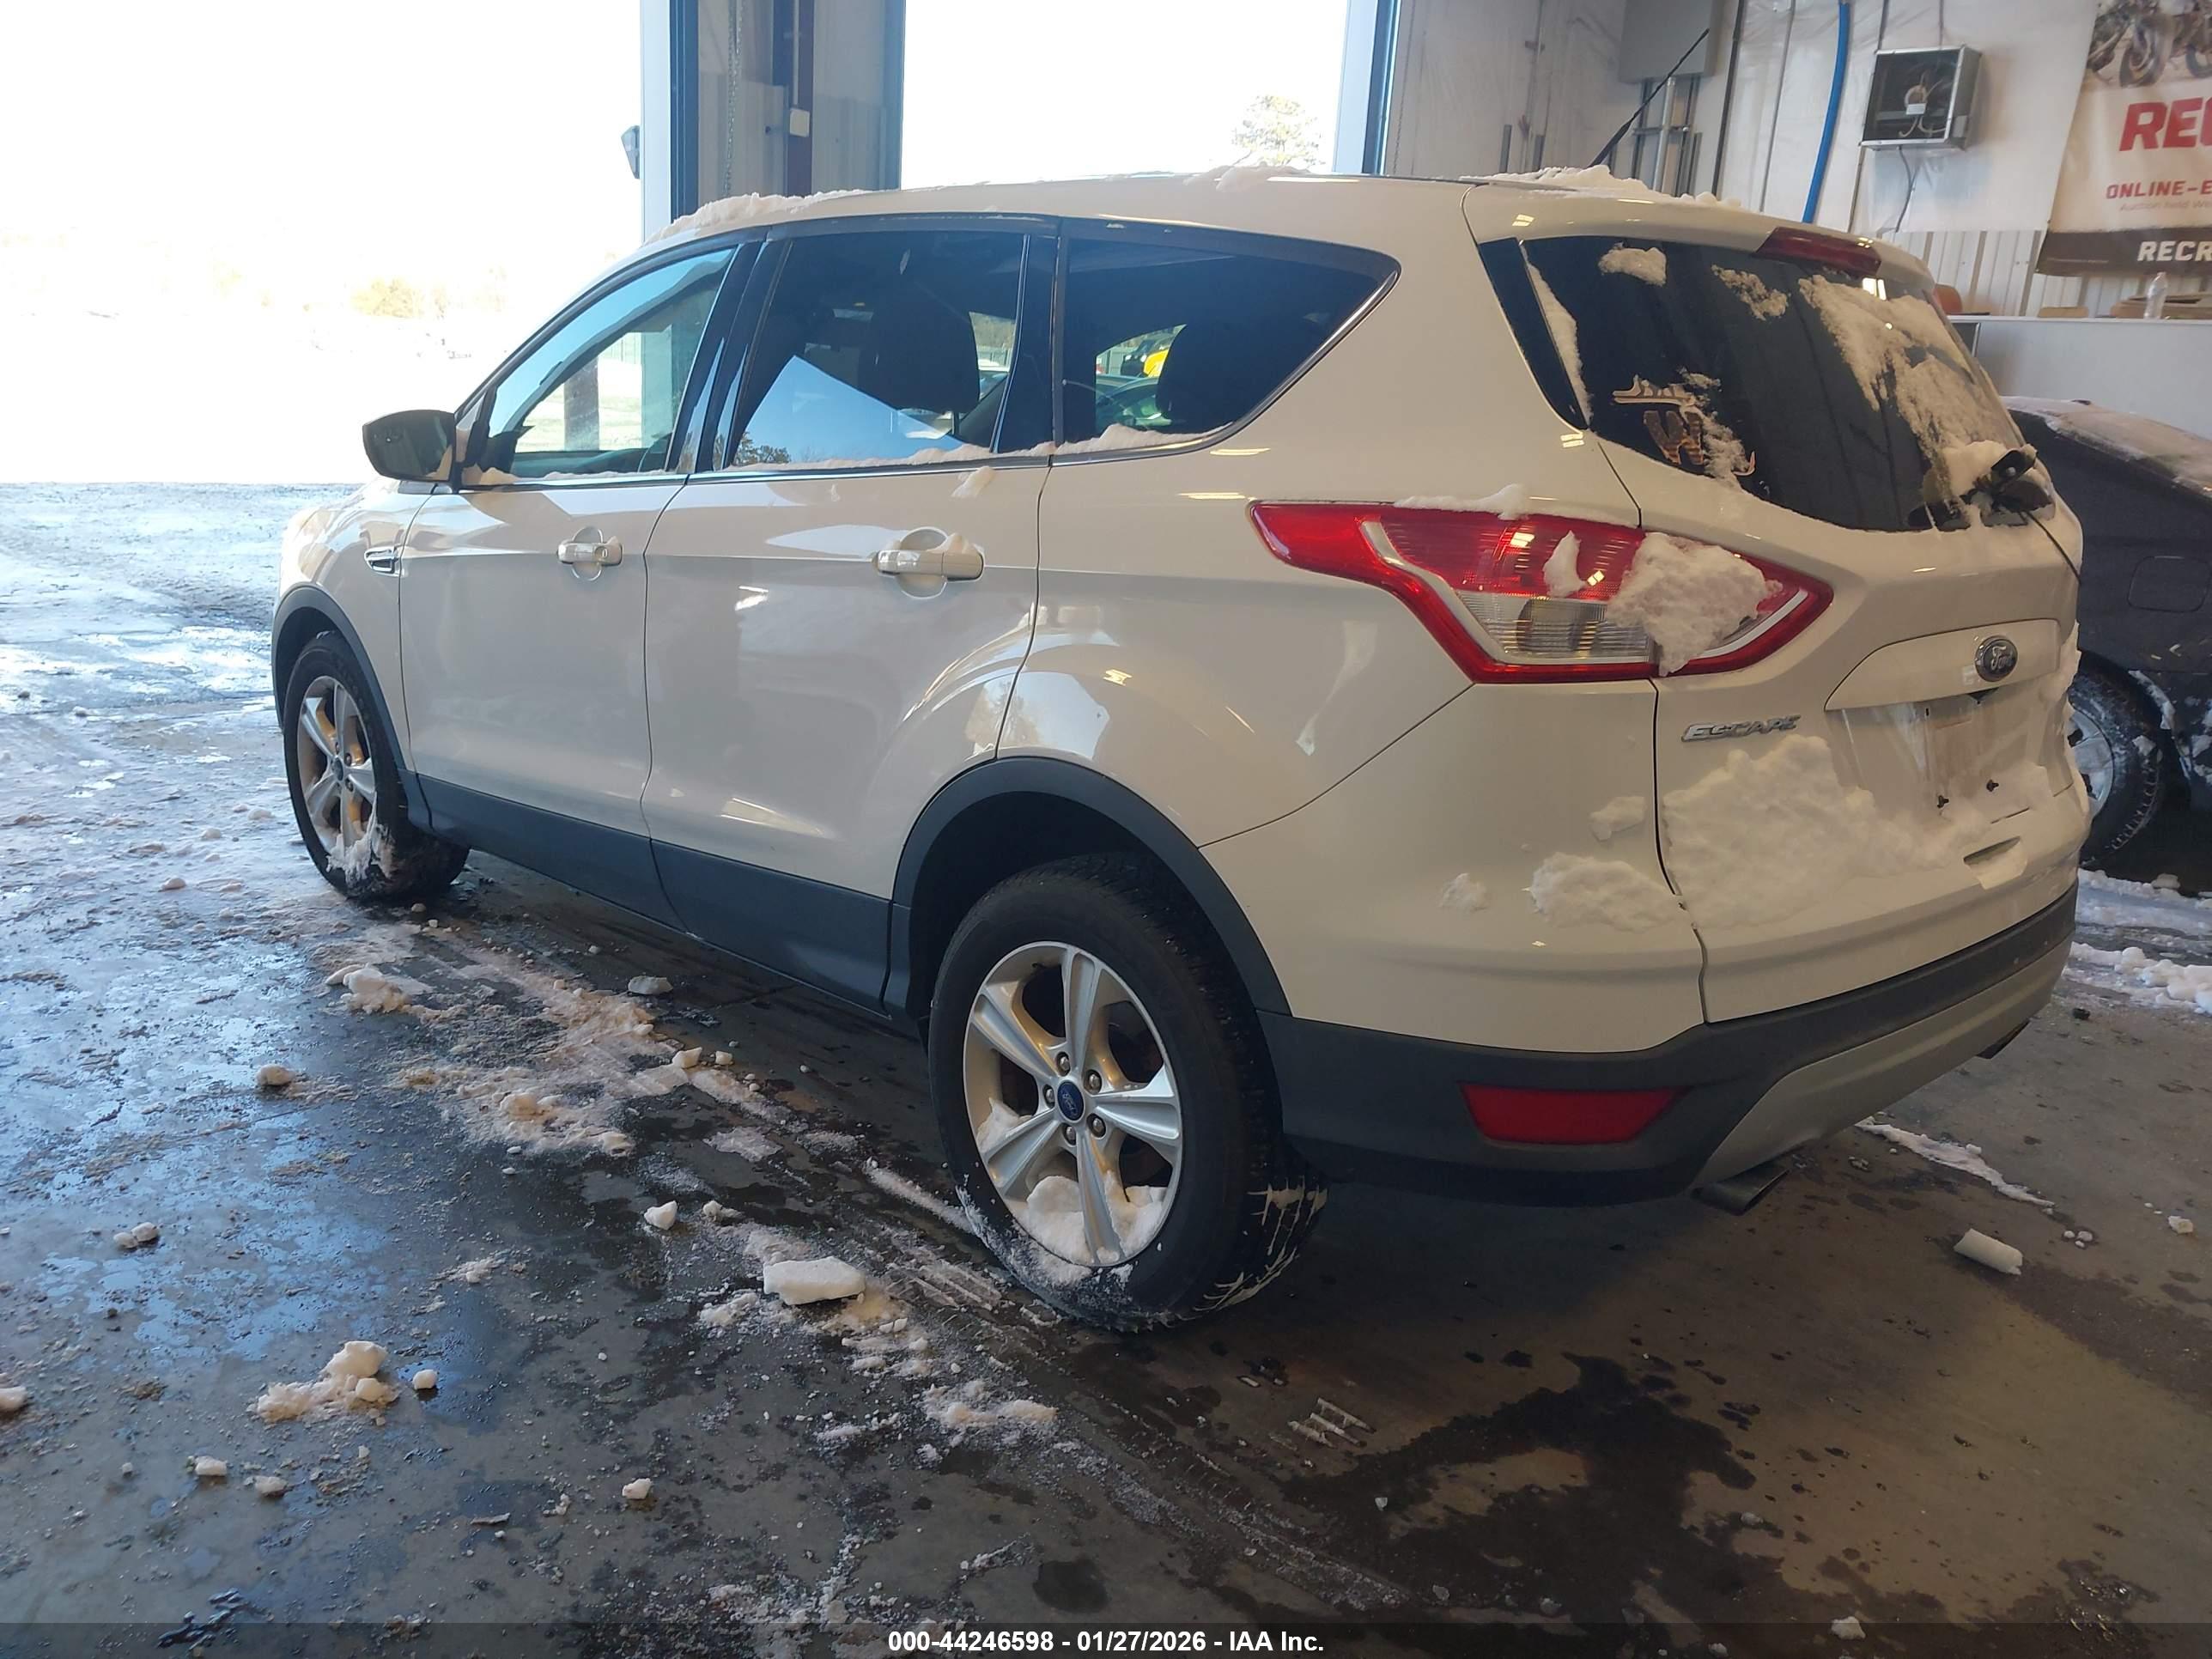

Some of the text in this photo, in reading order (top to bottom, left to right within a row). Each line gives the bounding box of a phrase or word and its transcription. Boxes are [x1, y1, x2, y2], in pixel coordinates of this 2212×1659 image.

[2118, 96, 2212, 151] RE
[2136, 240, 2212, 262] RECR
[1681, 714, 1802, 743] ESCAPE
